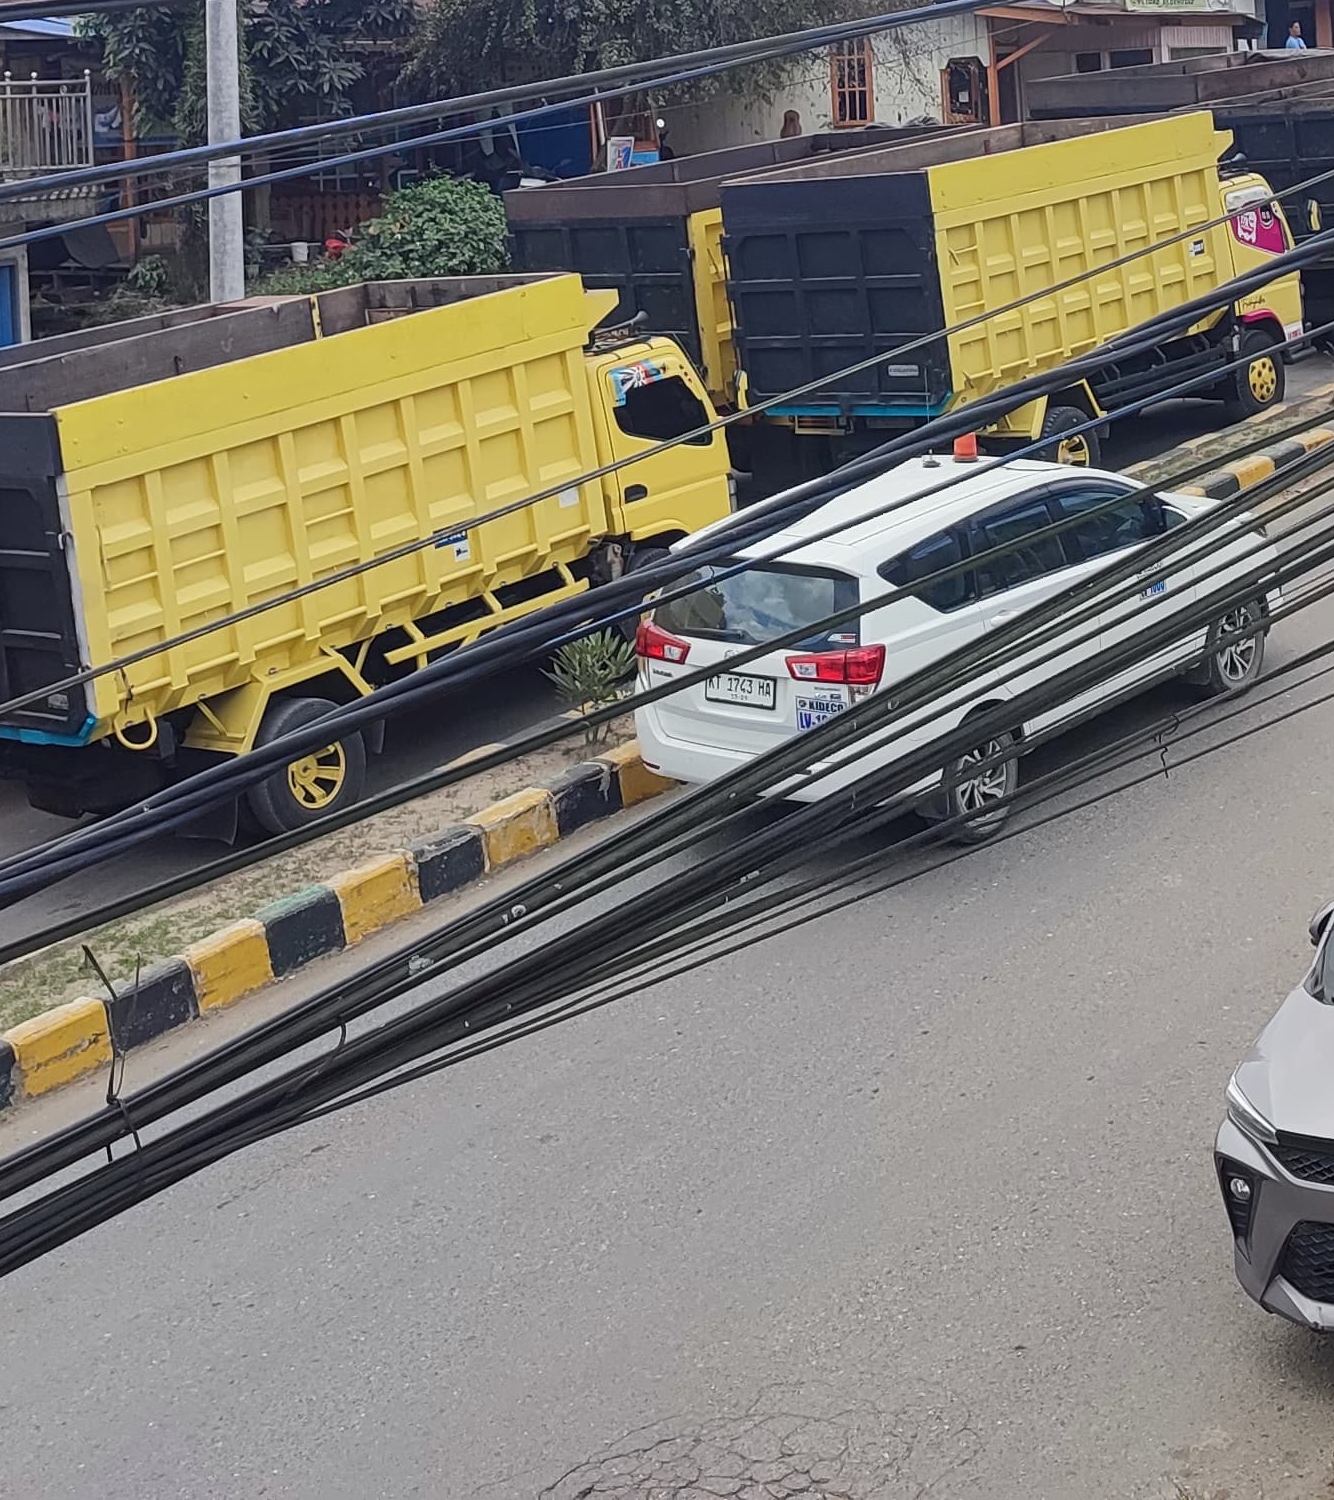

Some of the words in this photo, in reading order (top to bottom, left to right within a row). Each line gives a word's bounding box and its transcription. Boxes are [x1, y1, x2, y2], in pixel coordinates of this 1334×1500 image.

[708, 675, 721, 690] KT
[727, 677, 753, 694] 1743
[758, 680, 772, 697] HA
[809, 700, 844, 713] KIDECO
